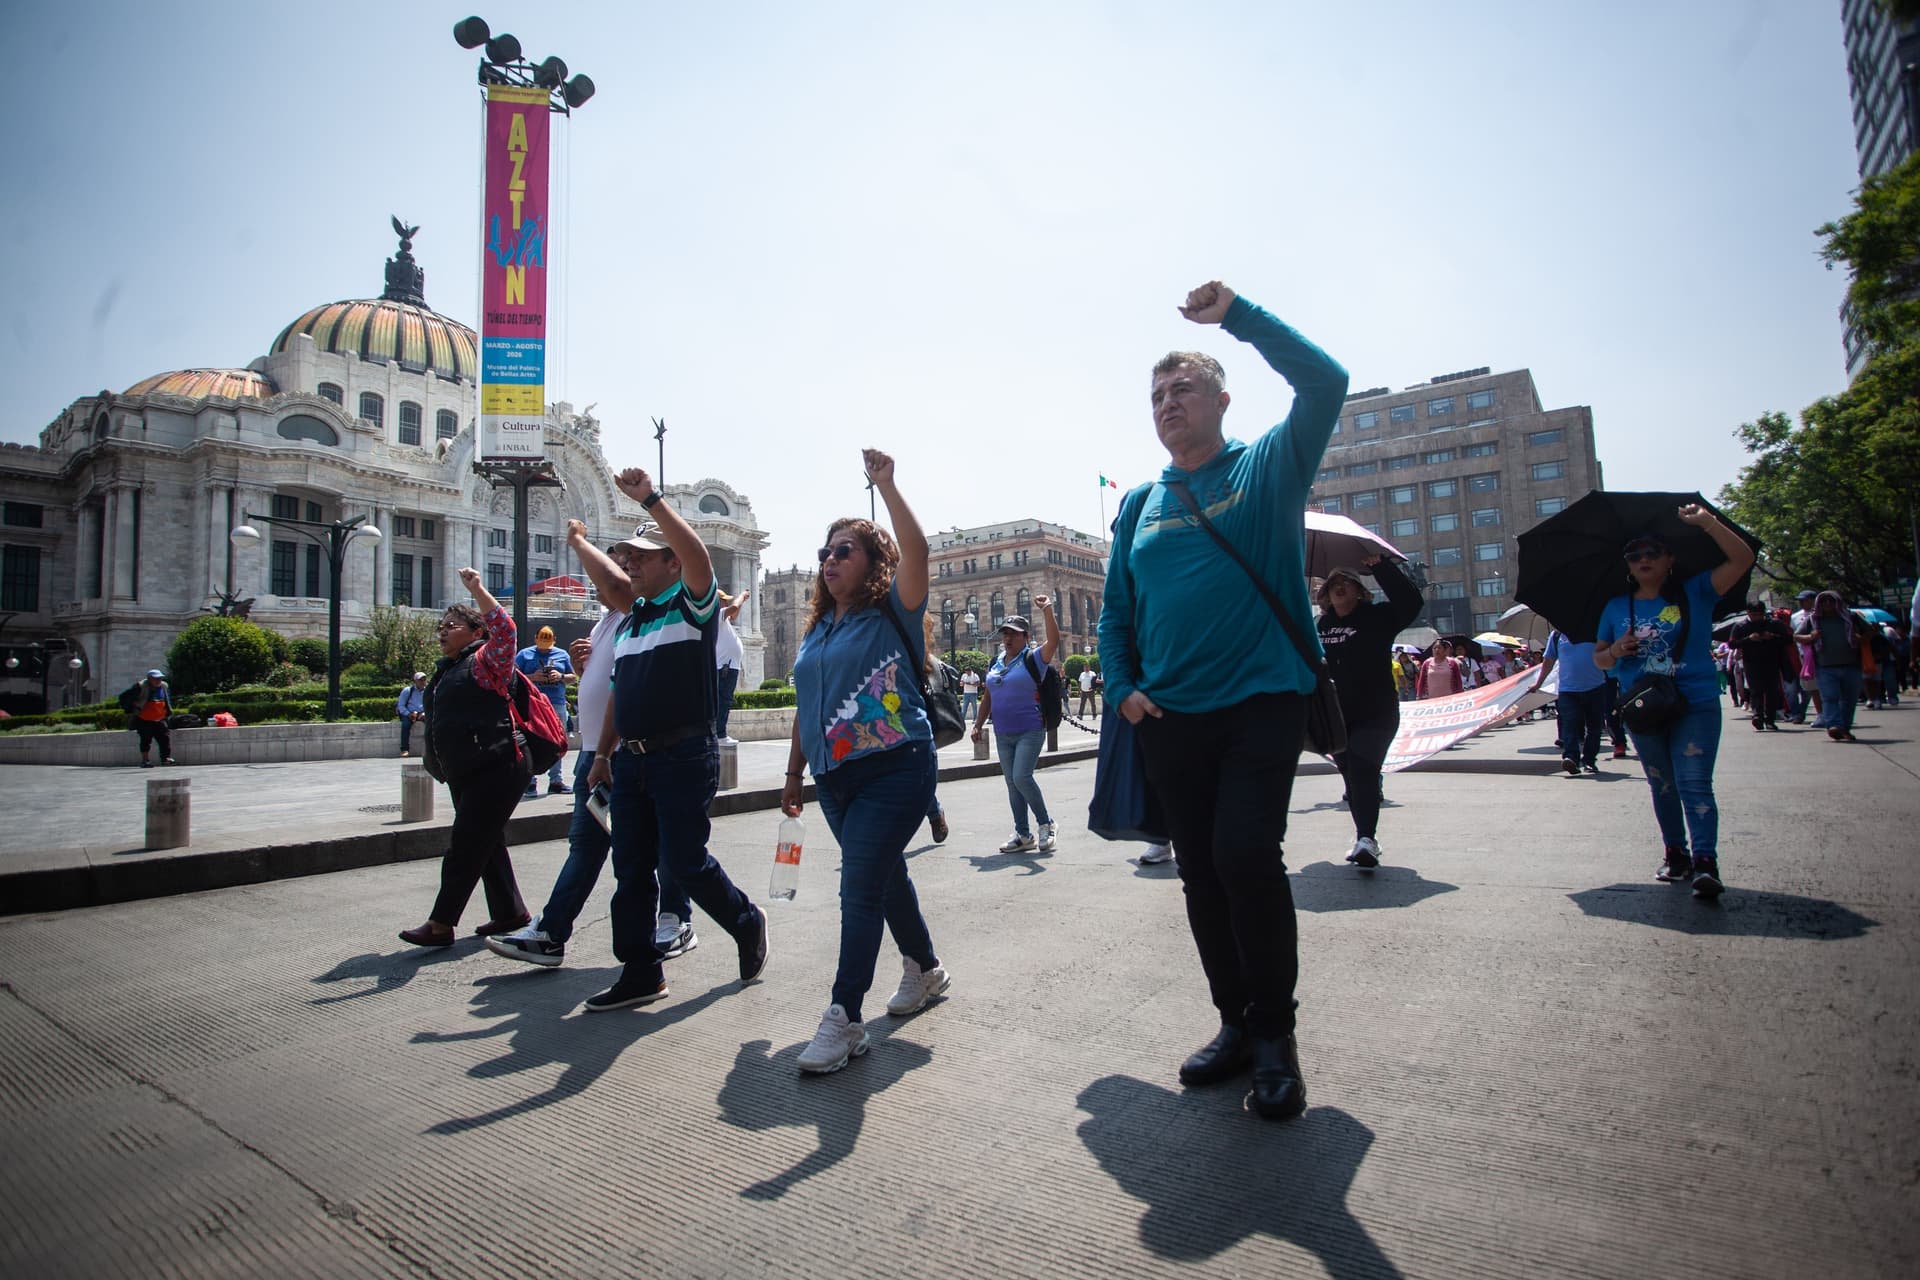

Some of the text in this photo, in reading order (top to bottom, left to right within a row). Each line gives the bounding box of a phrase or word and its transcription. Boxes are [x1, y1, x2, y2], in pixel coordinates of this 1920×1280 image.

[507, 313, 518, 325] DEL
[519, 313, 542, 326] TIEMPO
[486, 341, 511, 349] MARZO
[502, 421, 541, 431] Cultura
[502, 444, 531, 452] INBAL
[1413, 701, 1473, 716] OAXACA
